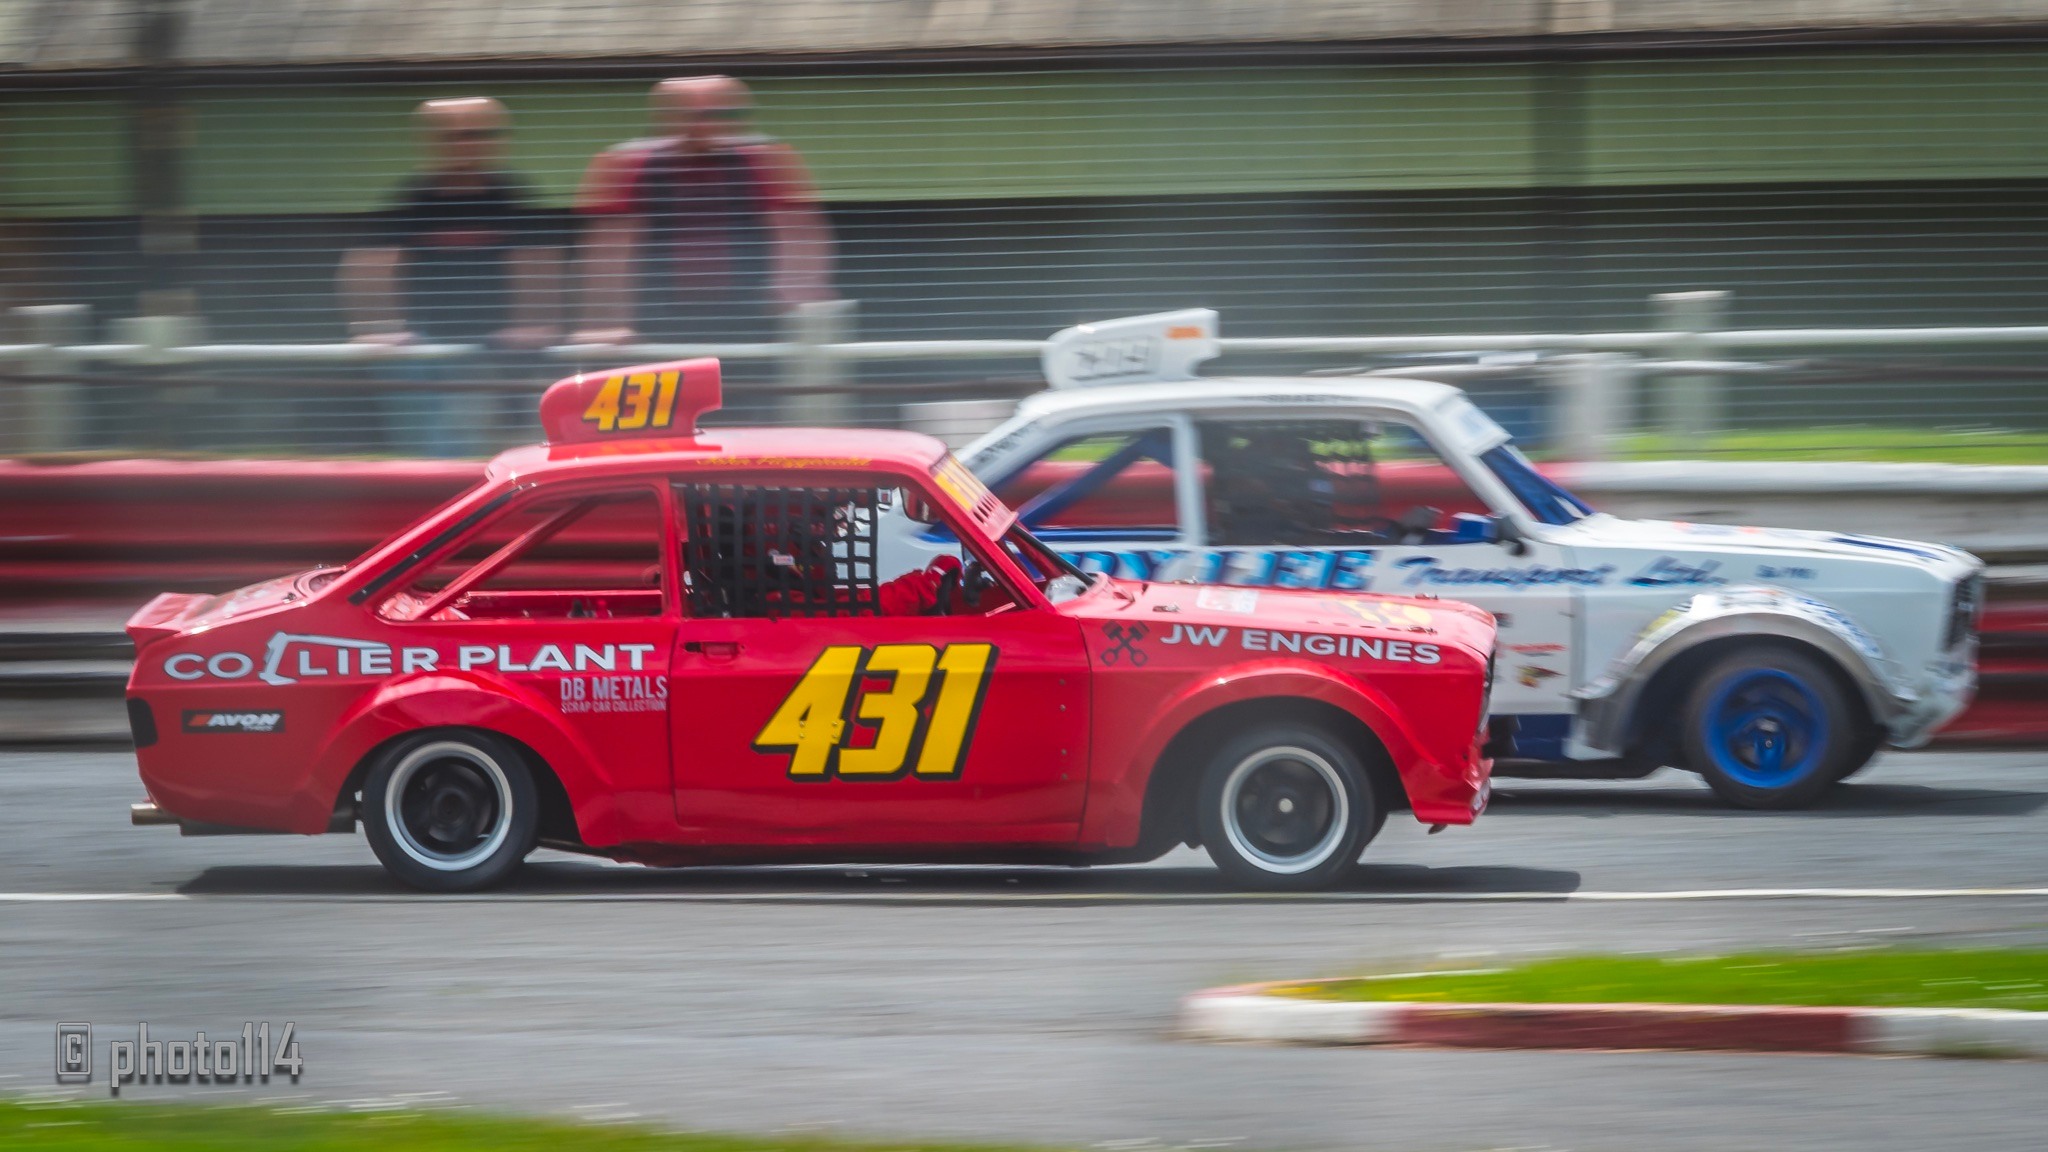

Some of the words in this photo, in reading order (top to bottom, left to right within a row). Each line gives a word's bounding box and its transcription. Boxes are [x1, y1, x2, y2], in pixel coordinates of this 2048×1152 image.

[582, 370, 684, 433] 431
[1196, 549, 1374, 592] LEE
[1393, 556, 1618, 592] Transport
[458, 643, 655, 672] PLANT
[1160, 622, 1229, 648] JW
[1241, 629, 1442, 665] ENGINES
[560, 677, 586, 701] DB
[592, 675, 668, 700] METALS
[207, 713, 281, 727] AVON
[561, 701, 591, 713] SCRAP
[592, 701, 611, 713] CAR
[612, 700, 667, 712] COLLECTION
[751, 643, 1000, 783] 431
